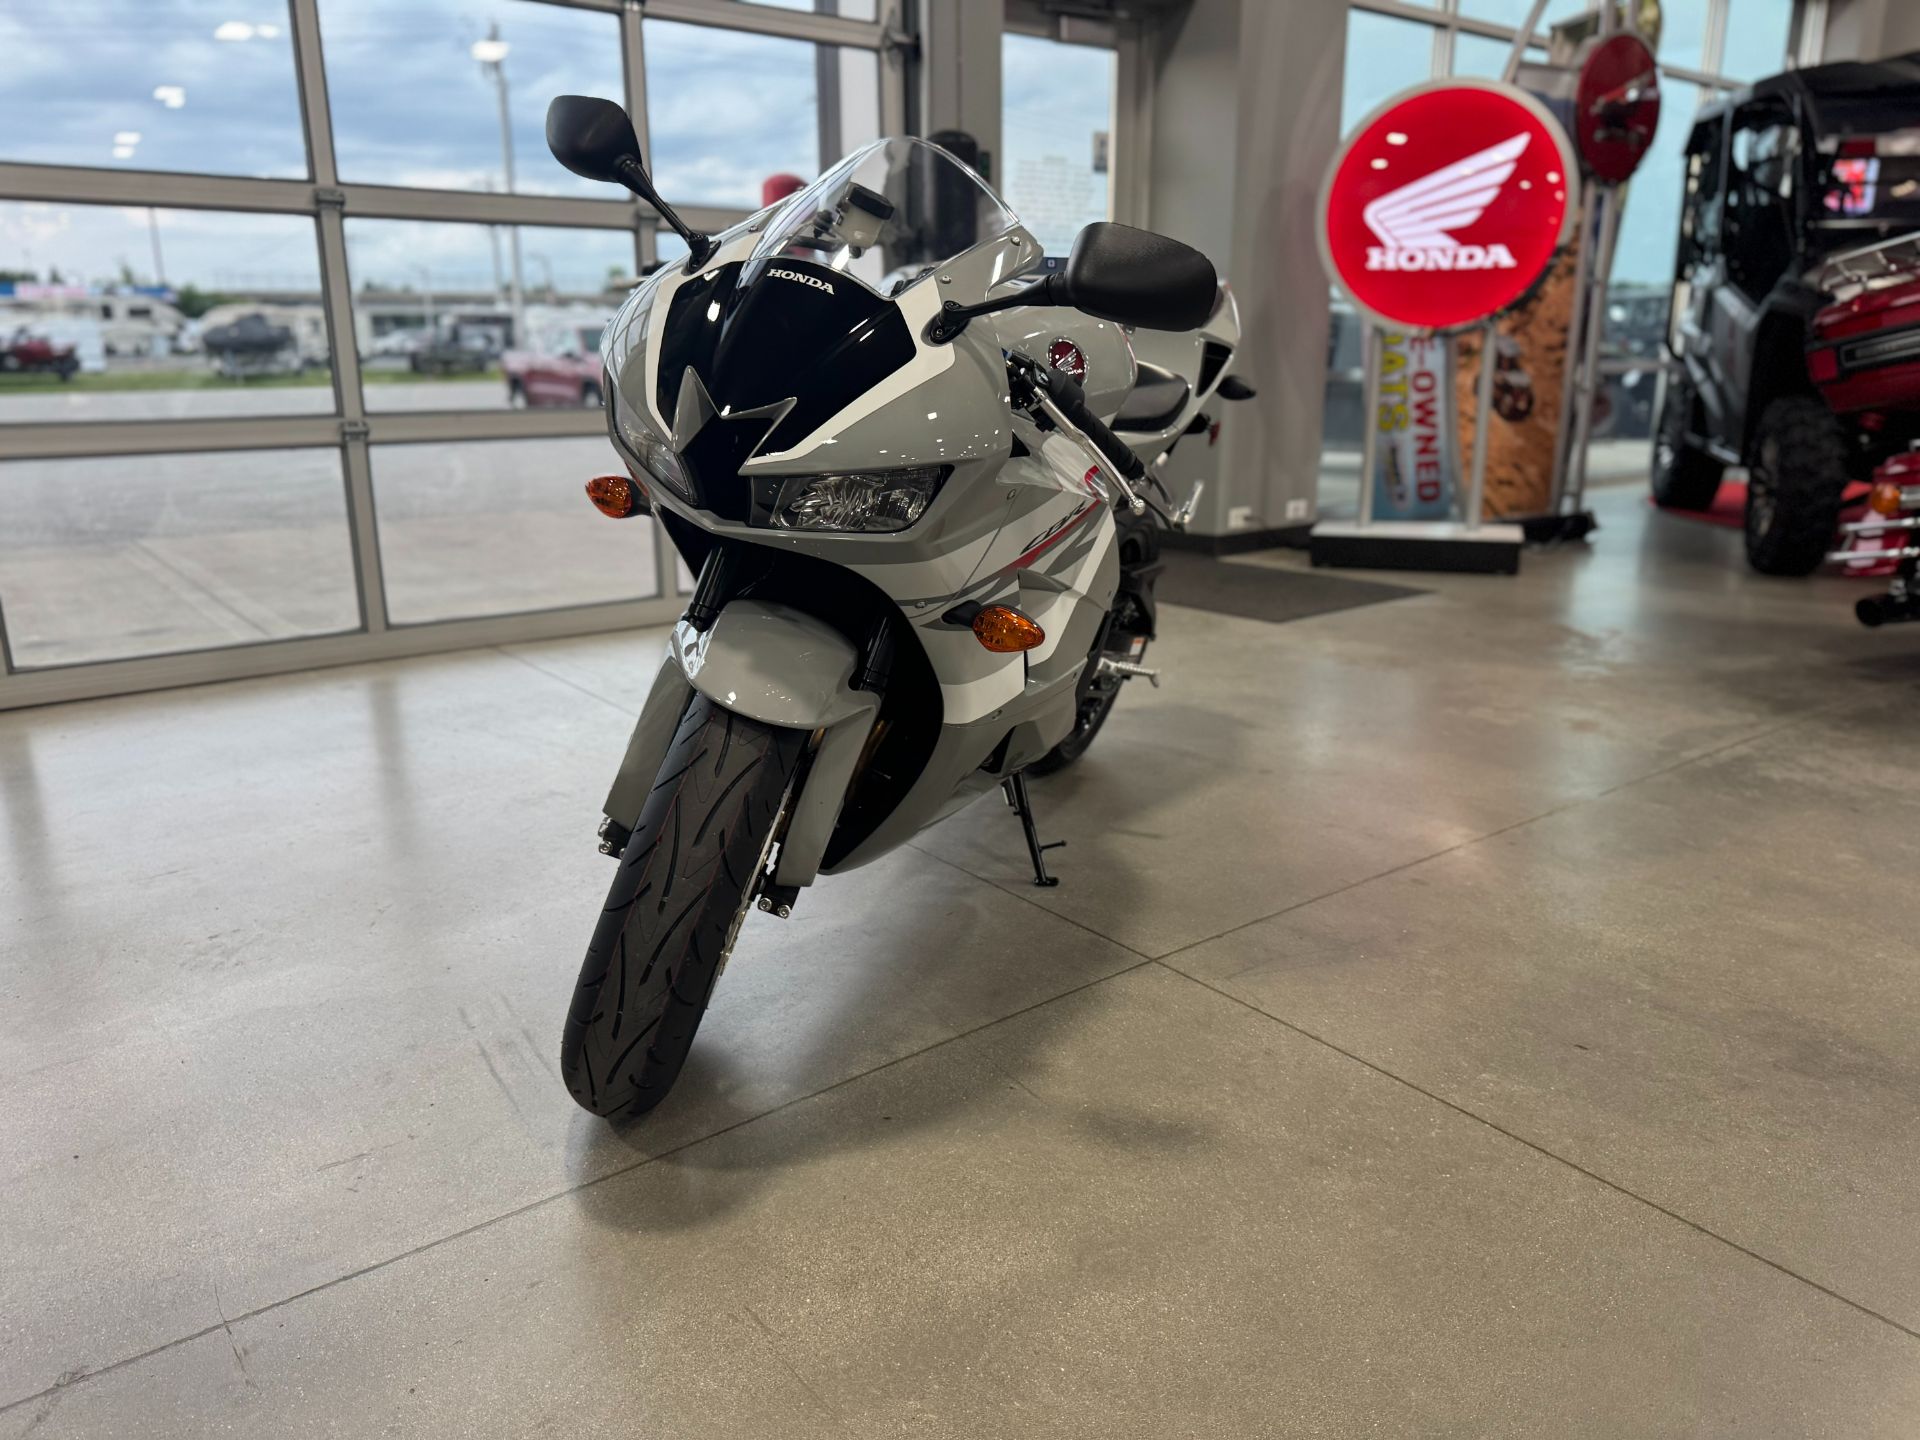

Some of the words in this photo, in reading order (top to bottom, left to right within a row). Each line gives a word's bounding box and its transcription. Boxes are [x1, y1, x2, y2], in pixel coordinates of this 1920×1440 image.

[1365, 244, 1518, 271] HONDA
[766, 268, 835, 296] HONDA
[1409, 336, 1441, 504] E-OWNED
[1019, 500, 1086, 556] CBR
